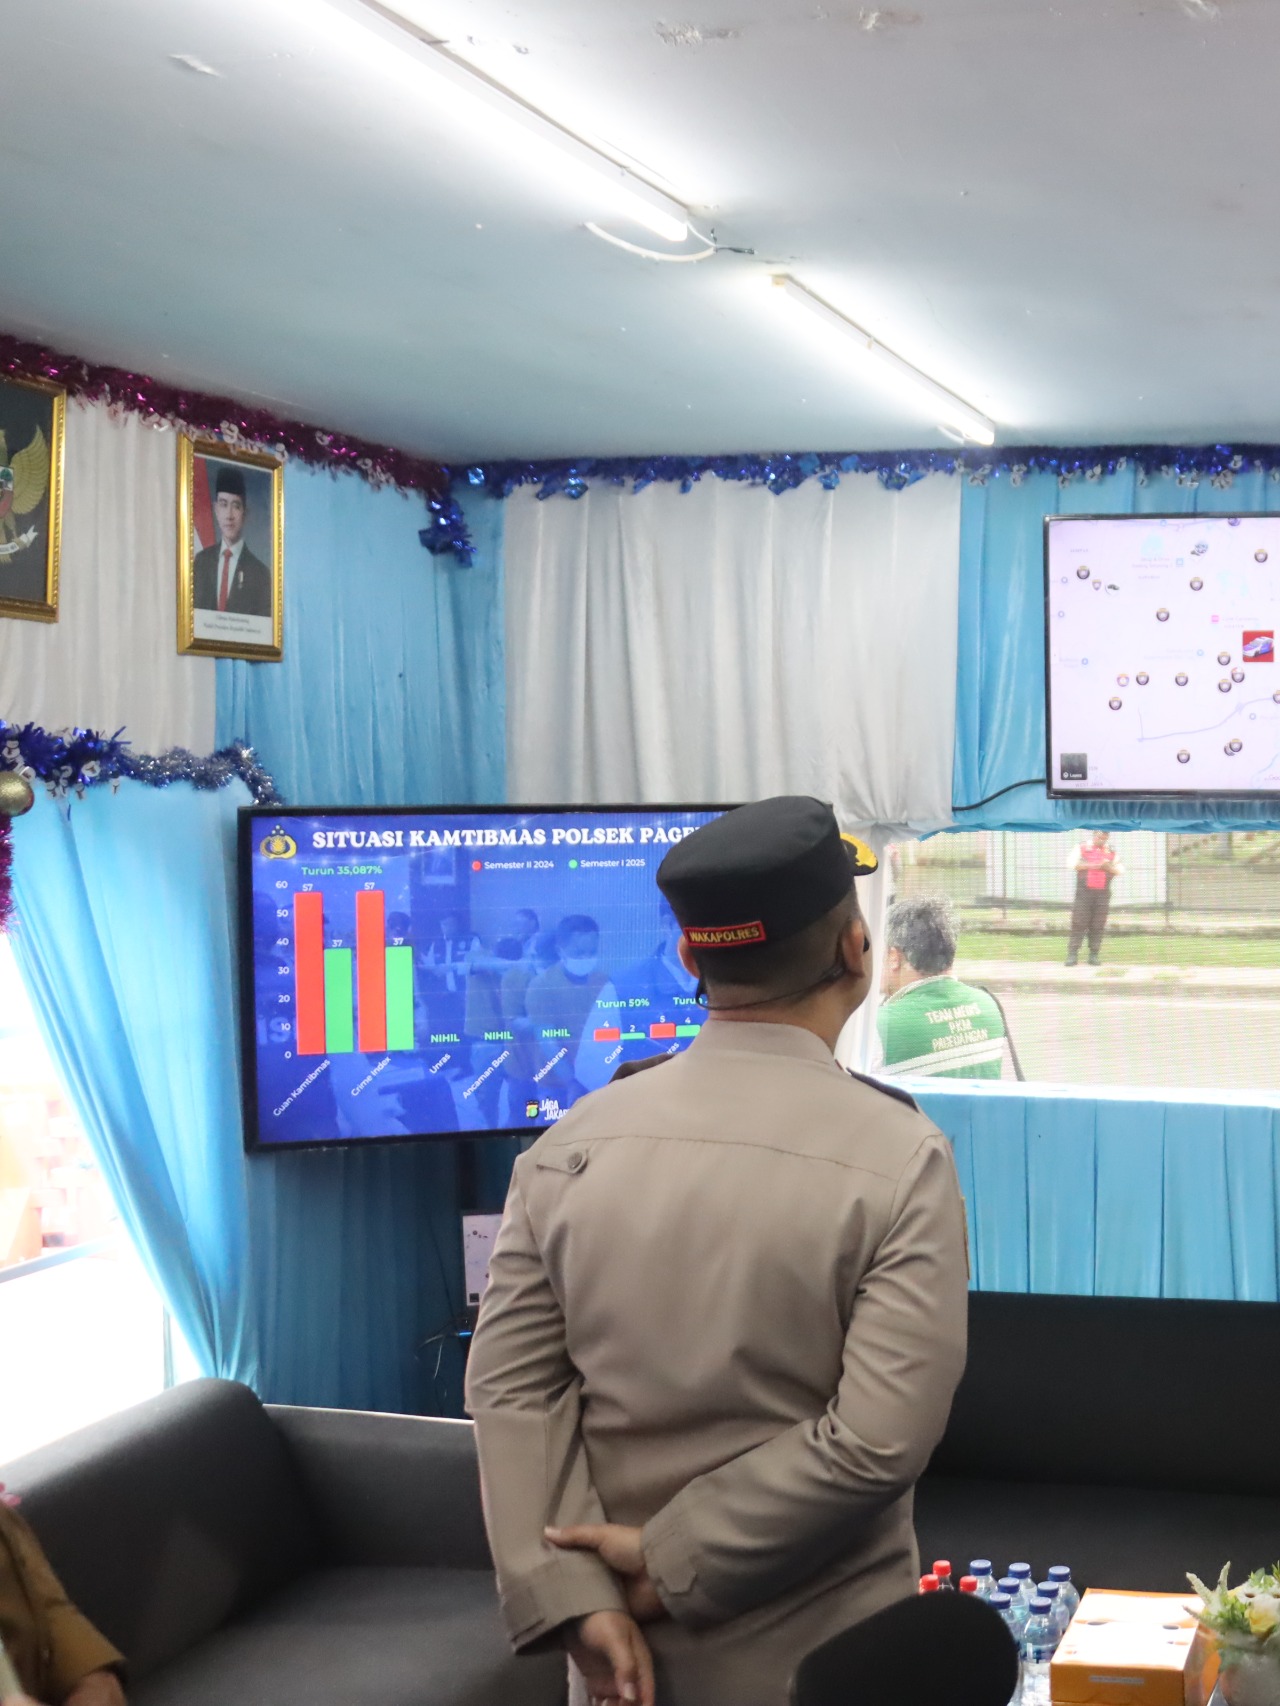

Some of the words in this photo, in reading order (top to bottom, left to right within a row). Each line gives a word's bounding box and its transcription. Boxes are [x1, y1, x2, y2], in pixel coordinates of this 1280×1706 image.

[312, 830, 404, 849] SITUASI
[409, 828, 546, 847] KAMTIBMAS
[551, 826, 635, 845] POLSEK
[484, 860, 525, 870] Semester
[533, 860, 555, 869] 2024
[580, 859, 620, 868] Semester
[625, 859, 646, 867] 2025
[301, 867, 334, 876] Turun
[336, 865, 383, 877] 35,087%
[275, 880, 289, 889] 60
[302, 883, 313, 892] 57
[363, 881, 376, 890] 57
[276, 909, 289, 918] 50
[689, 926, 760, 943] WAKAPOLRES
[276, 937, 289, 946] 40
[332, 939, 343, 947] 37
[392, 937, 404, 946] 37
[278, 966, 290, 975] 30
[278, 994, 291, 1003] 20
[595, 999, 627, 1009] Turun
[628, 998, 650, 1007] 50%
[660, 1015, 666, 1023] 5
[684, 1016, 691, 1024] 4
[924, 1008, 954, 1024] TEAM
[281, 1022, 291, 1031] 10
[603, 1020, 609, 1028] 4
[629, 1024, 636, 1032] 2
[484, 1030, 514, 1041] NIHIL
[541, 1028, 571, 1038] NIHIL
[430, 1033, 460, 1043] NIHIL
[284, 1050, 292, 1059] 0
[604, 1044, 624, 1064] Curat
[429, 1052, 451, 1075] Unras
[532, 1046, 569, 1084] Kebakaran
[350, 1075, 373, 1097] Crime
[370, 1056, 392, 1077] Index
[462, 1066, 495, 1100] Ancaman
[491, 1050, 511, 1070] Bom
[272, 1095, 294, 1117] Guan
[290, 1058, 331, 1098] Kamtibmas
